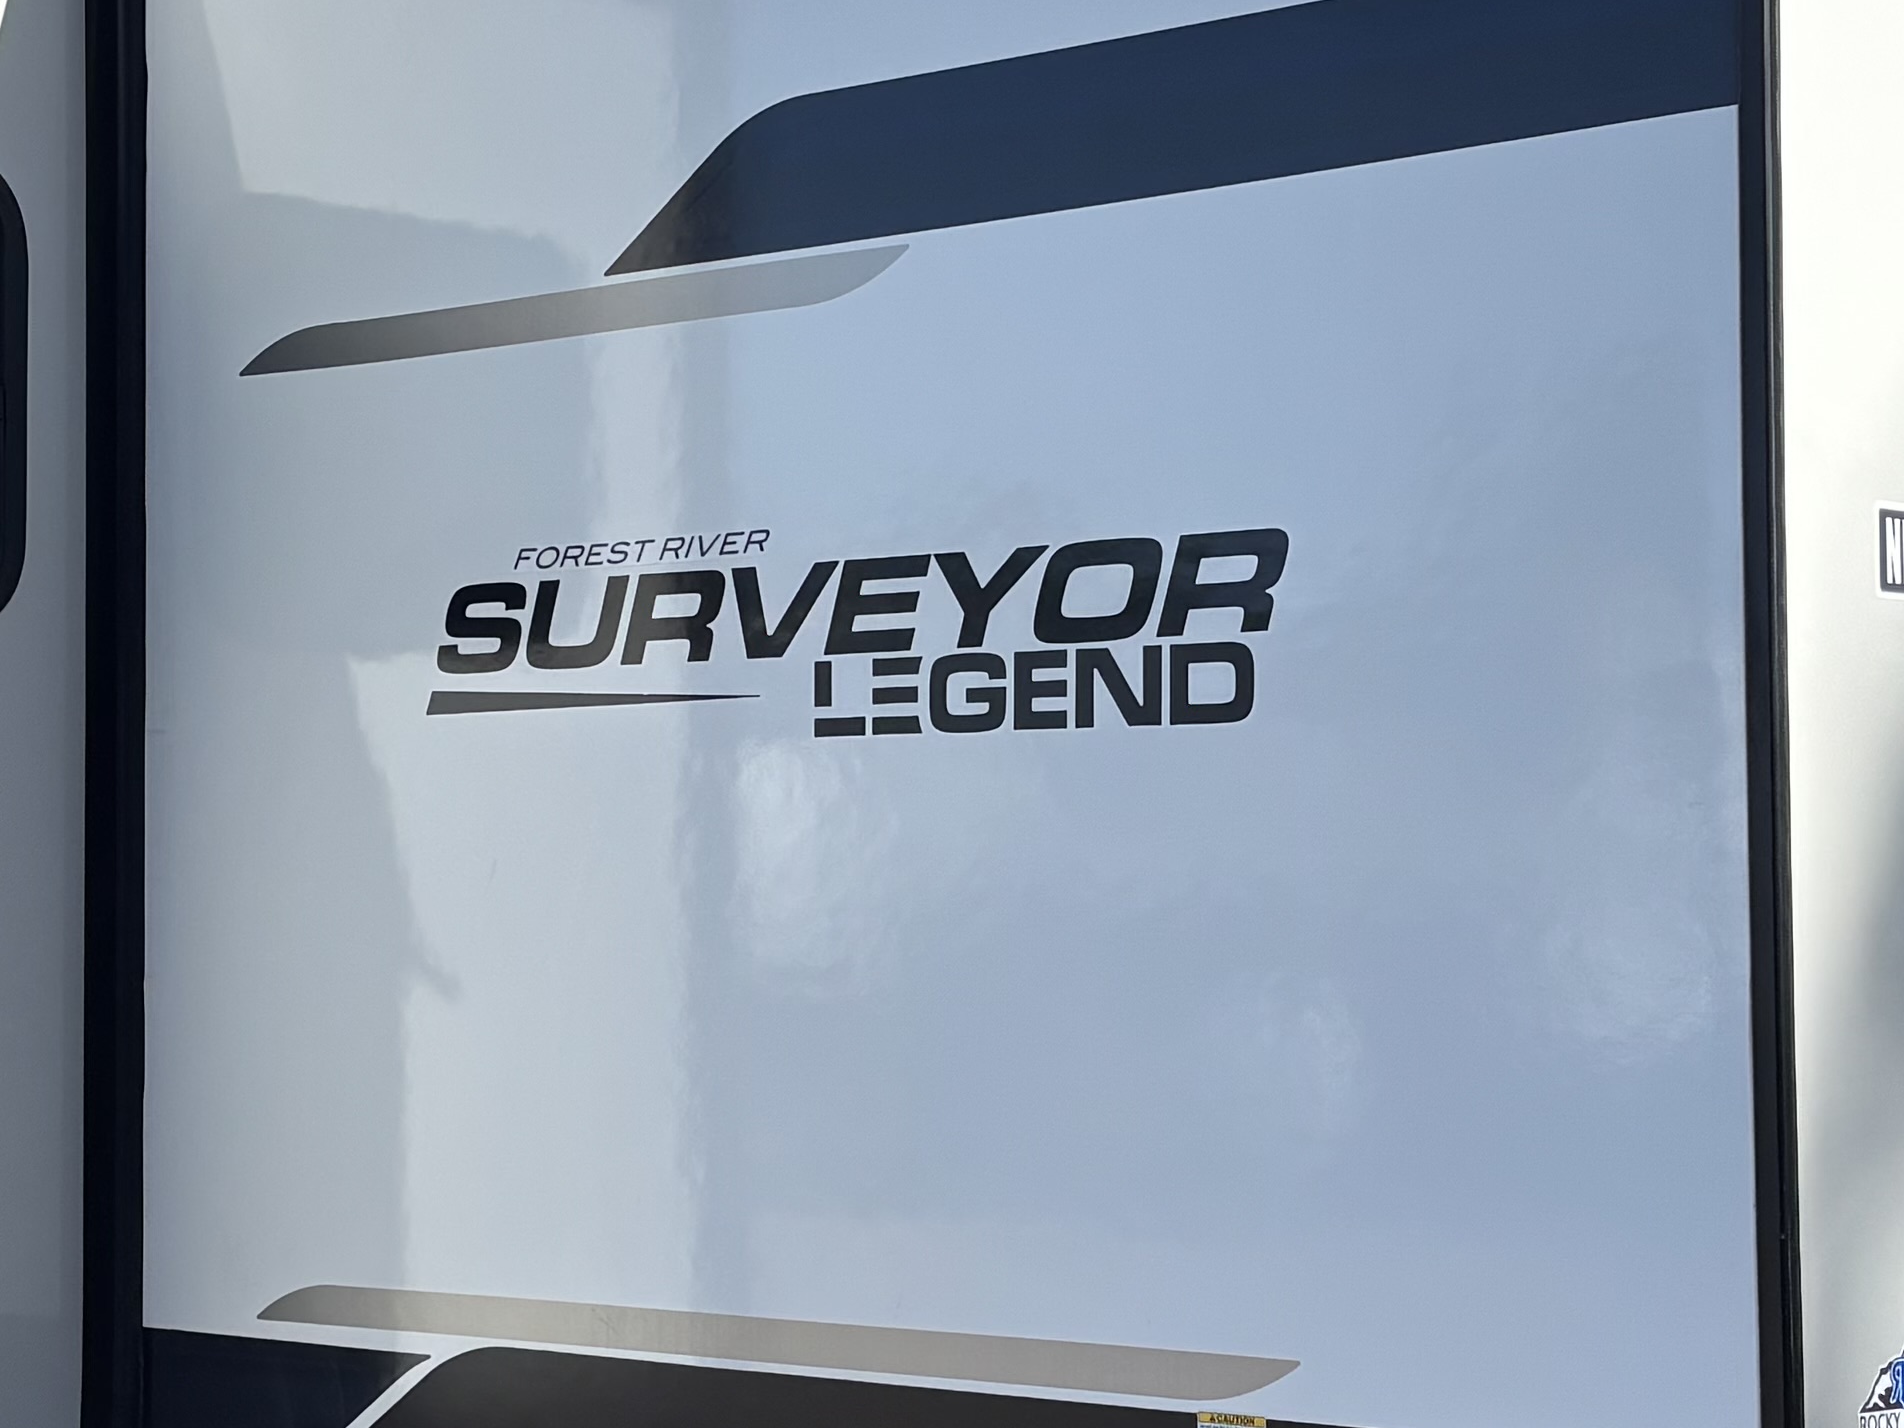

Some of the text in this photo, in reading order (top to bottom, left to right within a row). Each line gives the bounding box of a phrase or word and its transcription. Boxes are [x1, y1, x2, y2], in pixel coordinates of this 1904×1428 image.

[513, 529, 771, 571] FOREST RIVER
[436, 527, 1290, 674] SURVEYOR
[813, 641, 1254, 738] LEGEND
